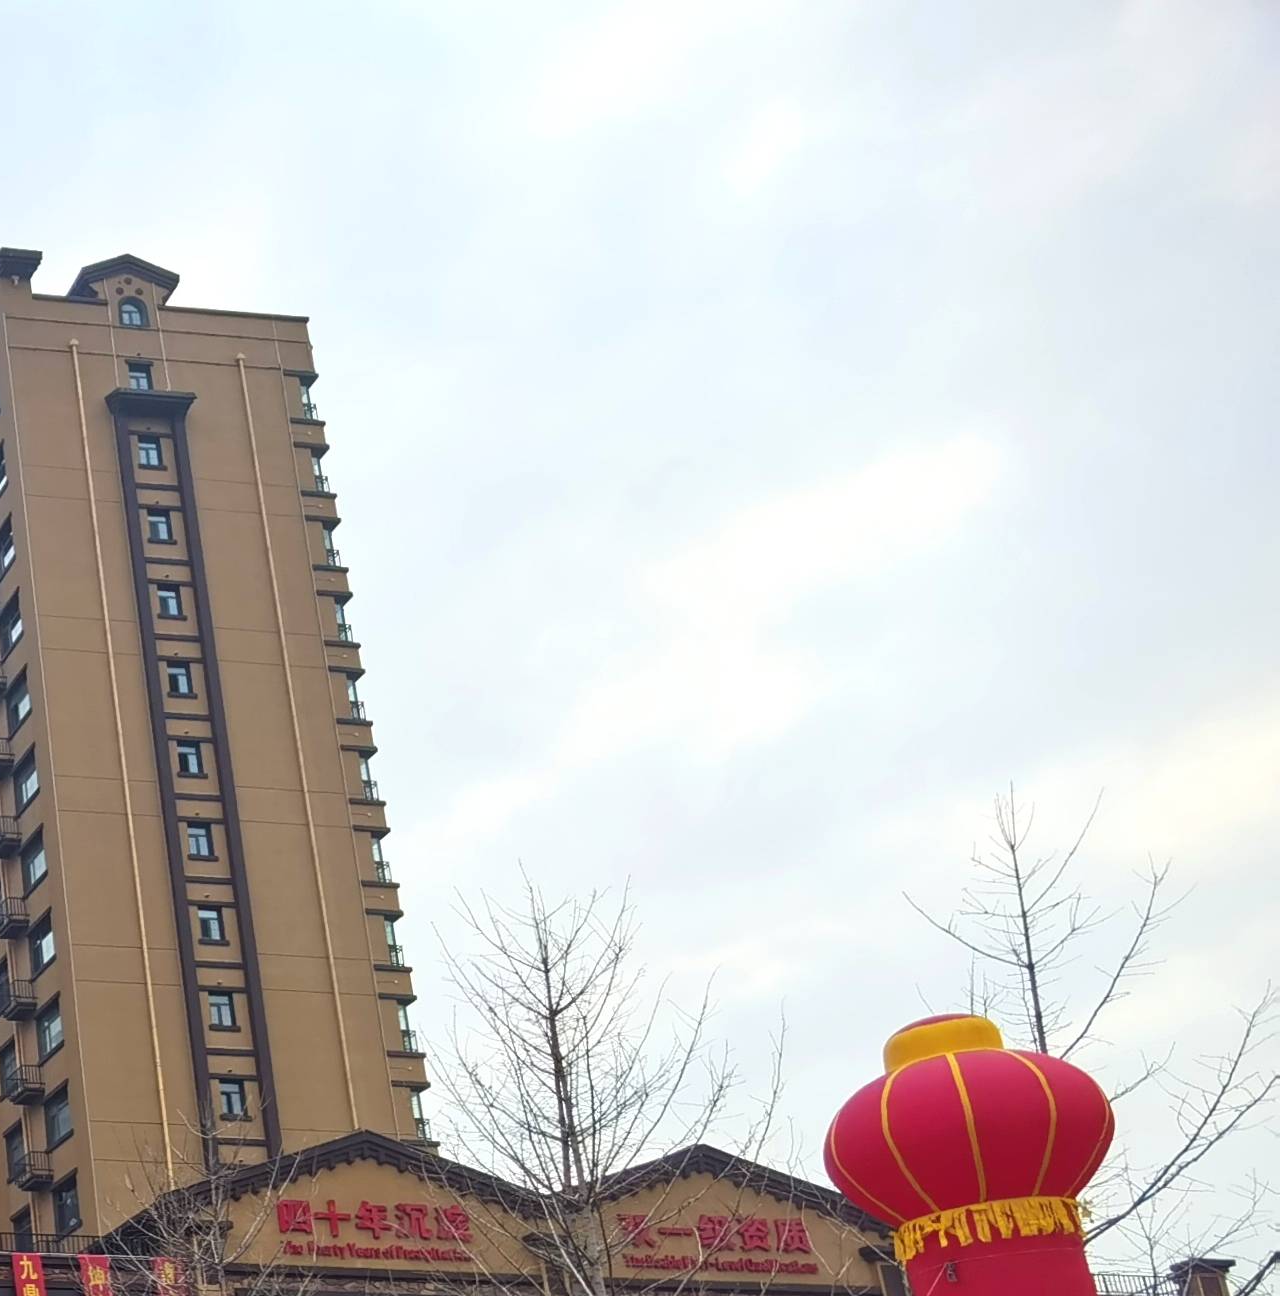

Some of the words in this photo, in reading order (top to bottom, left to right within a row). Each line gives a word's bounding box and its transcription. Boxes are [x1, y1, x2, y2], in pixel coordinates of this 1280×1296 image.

[277, 1200, 472, 1242] 四十年沉淀
